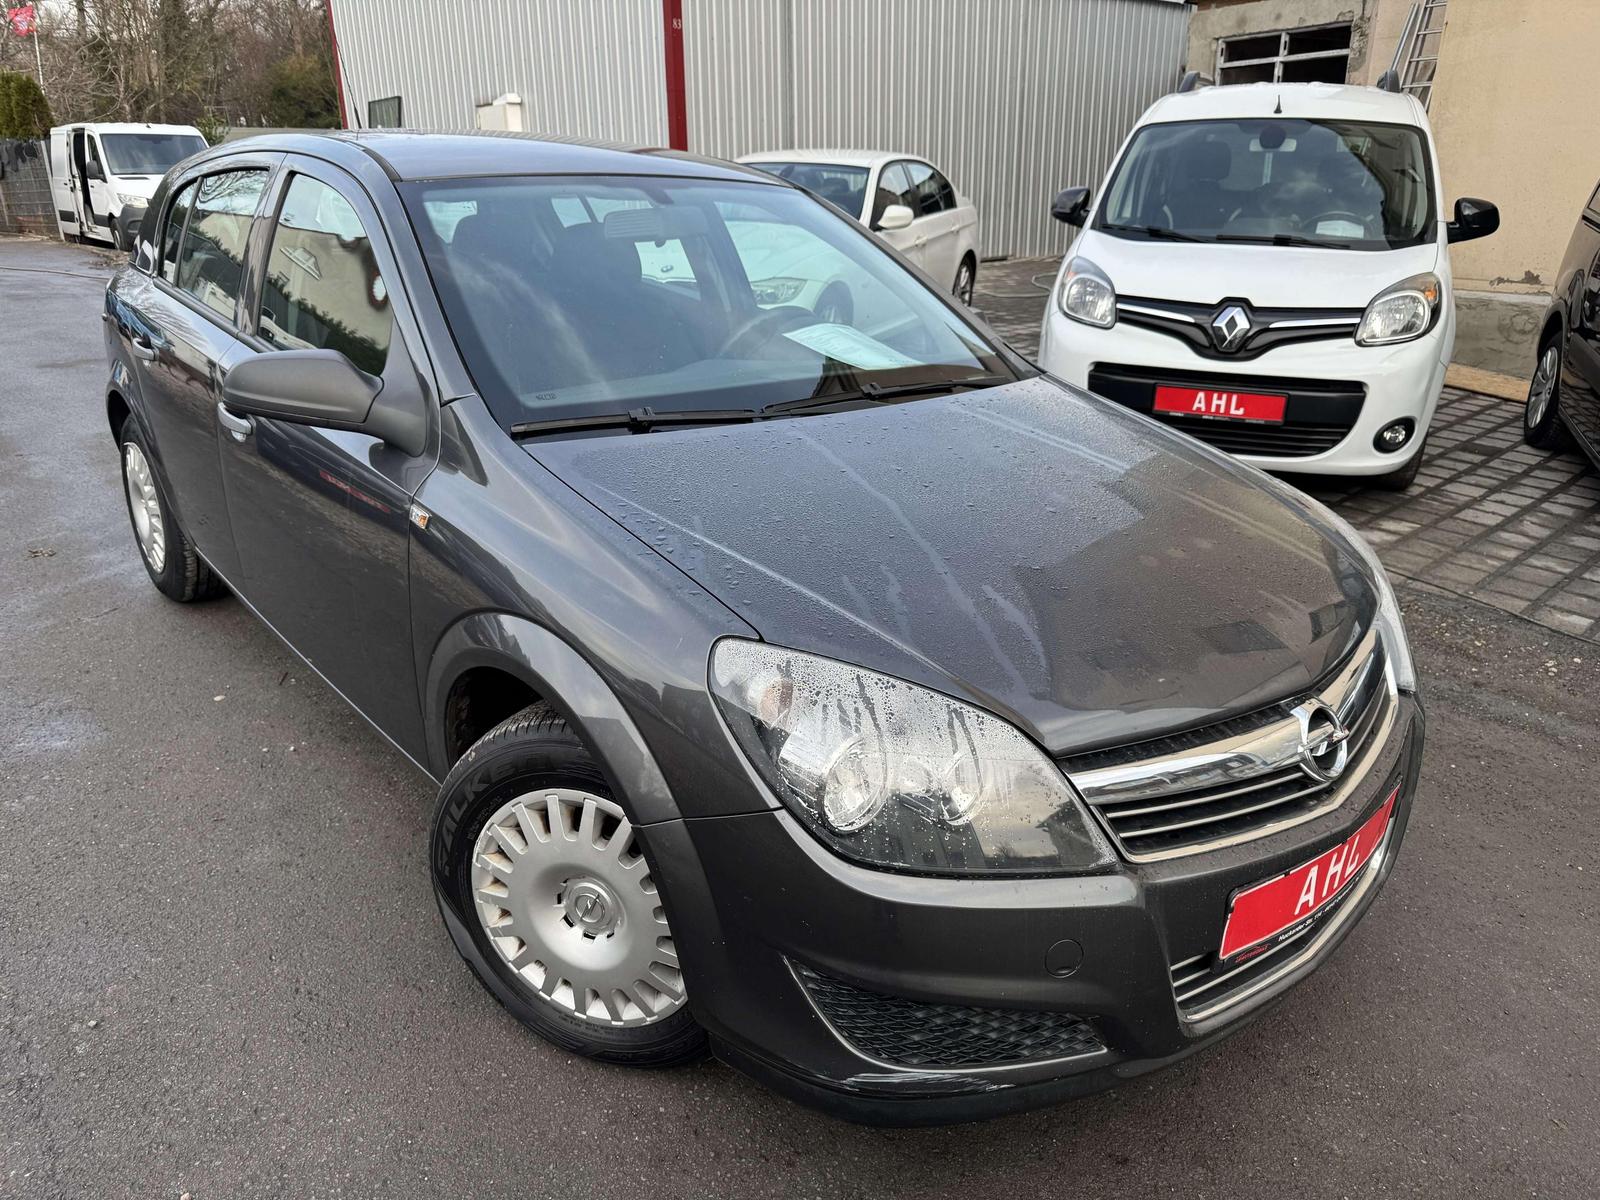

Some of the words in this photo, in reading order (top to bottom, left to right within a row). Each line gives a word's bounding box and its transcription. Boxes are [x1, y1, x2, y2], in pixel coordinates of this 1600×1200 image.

[672, 17, 682, 30] 83
[1193, 392, 1245, 415] AHL
[1294, 835, 1360, 915] AHL
